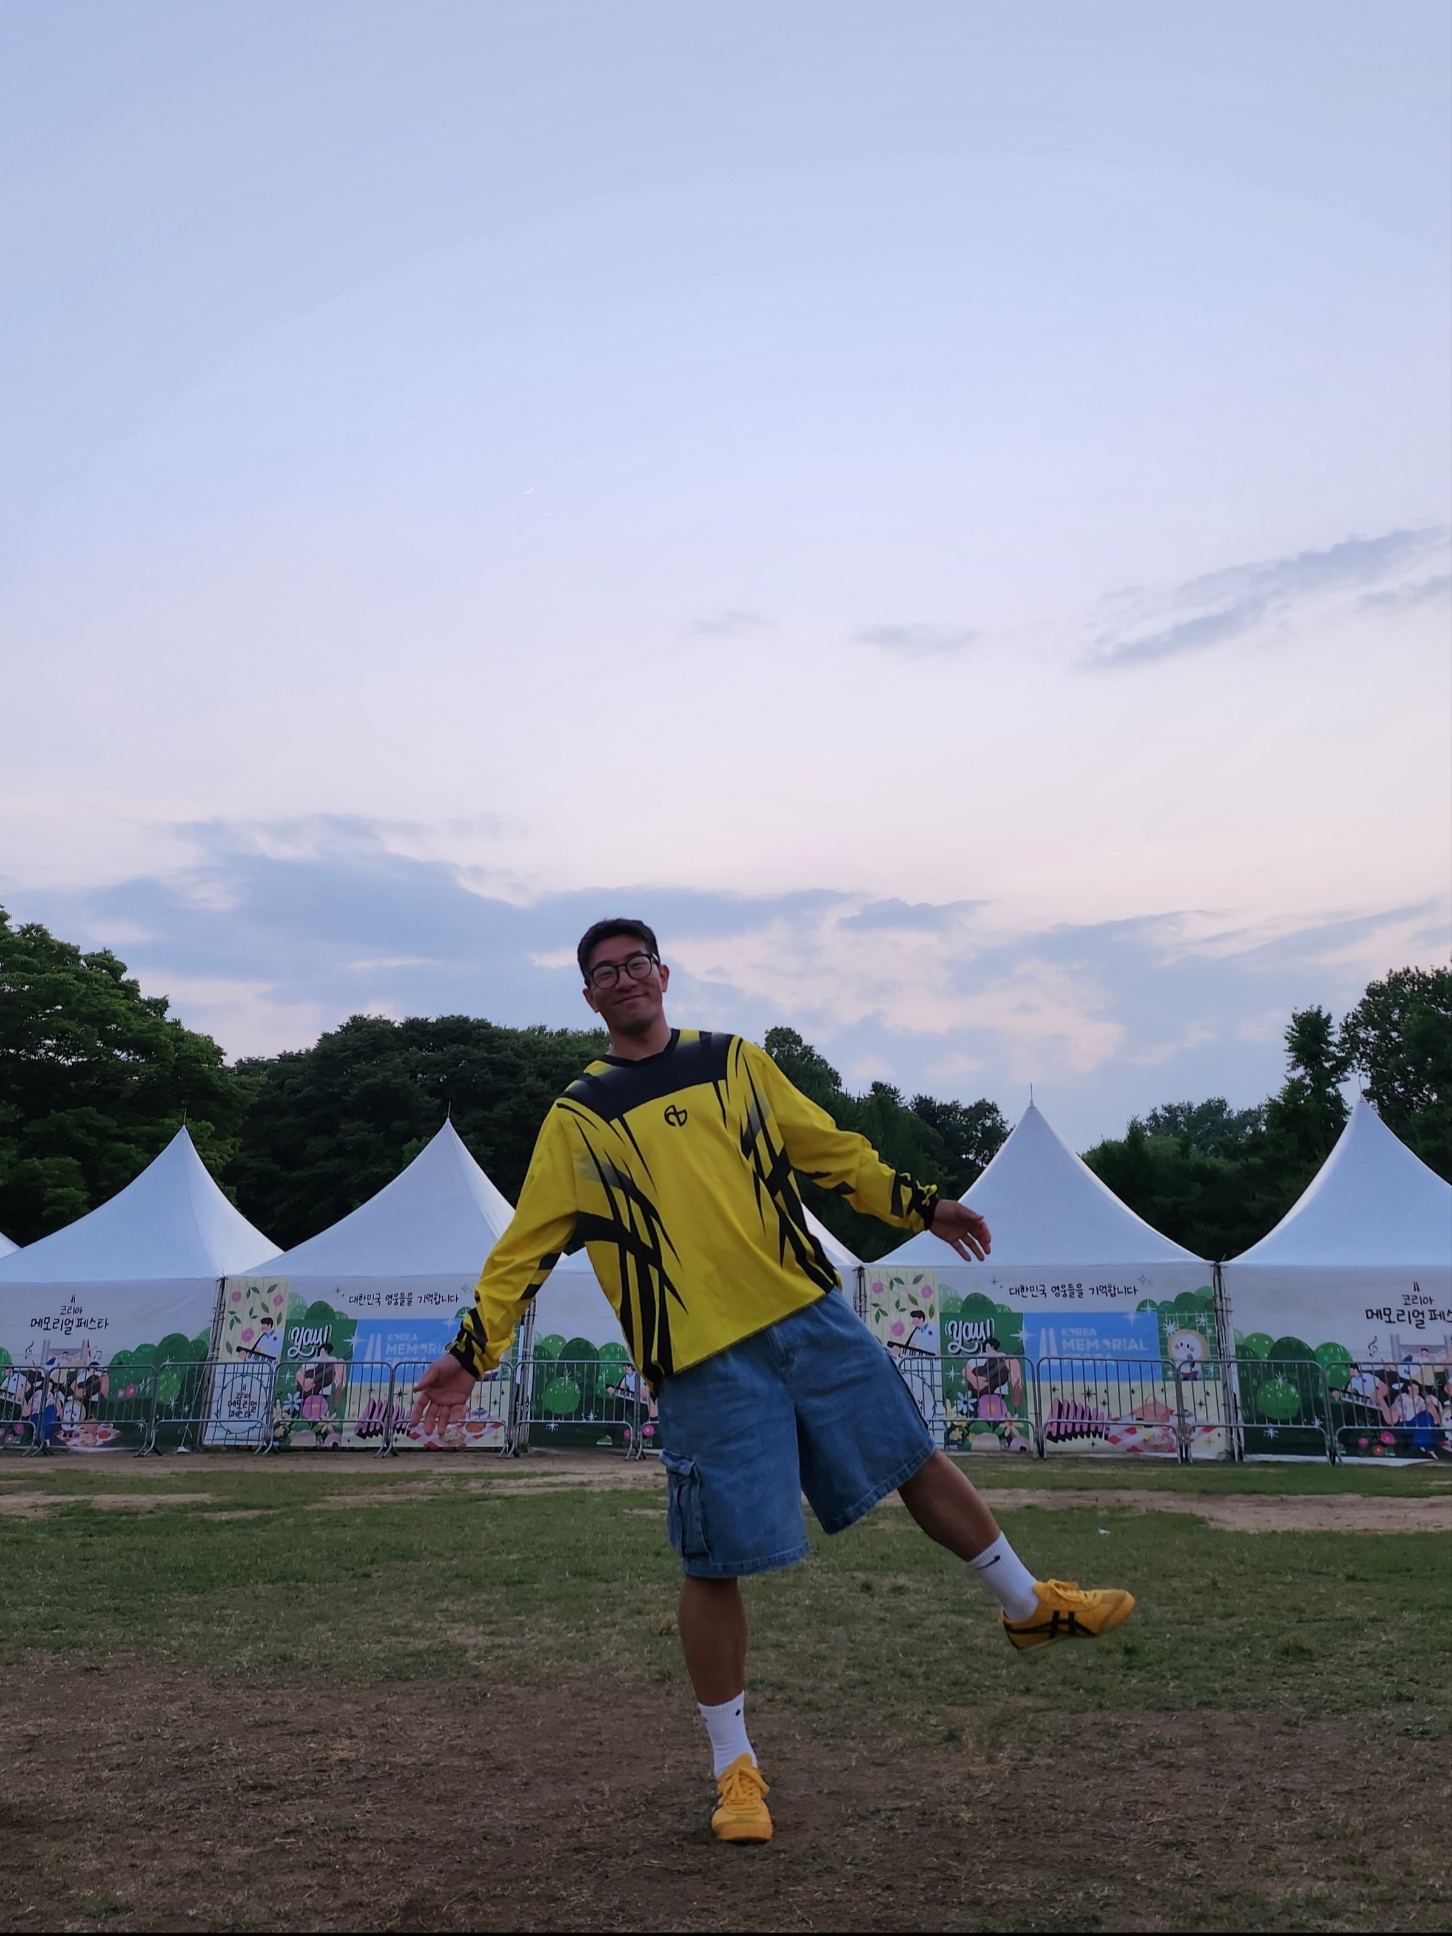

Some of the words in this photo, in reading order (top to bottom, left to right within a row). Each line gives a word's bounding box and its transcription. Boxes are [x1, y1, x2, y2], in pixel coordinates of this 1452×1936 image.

[1009, 1284, 1047, 1298] 대한민국
[1051, 1283, 1084, 1298] 영웅들을
[1089, 1284, 1138, 1298] 기억합니다
[348, 1292, 381, 1306] 대한민국
[385, 1292, 413, 1306] 영웅들을
[417, 1292, 459, 1305] 기억합니다
[1401, 1294, 1434, 1306] 코리아
[60, 1305, 83, 1315] 코리아
[1365, 1307, 1426, 1329] 메모리얼
[30, 1316, 74, 1335] 메모리얼
[76, 1317, 109, 1330] 페스타
[387, 1333, 418, 1342] KOREA
[1061, 1328, 1097, 1337] KOREA
[1061, 1338, 1149, 1351] MEMORIAL
